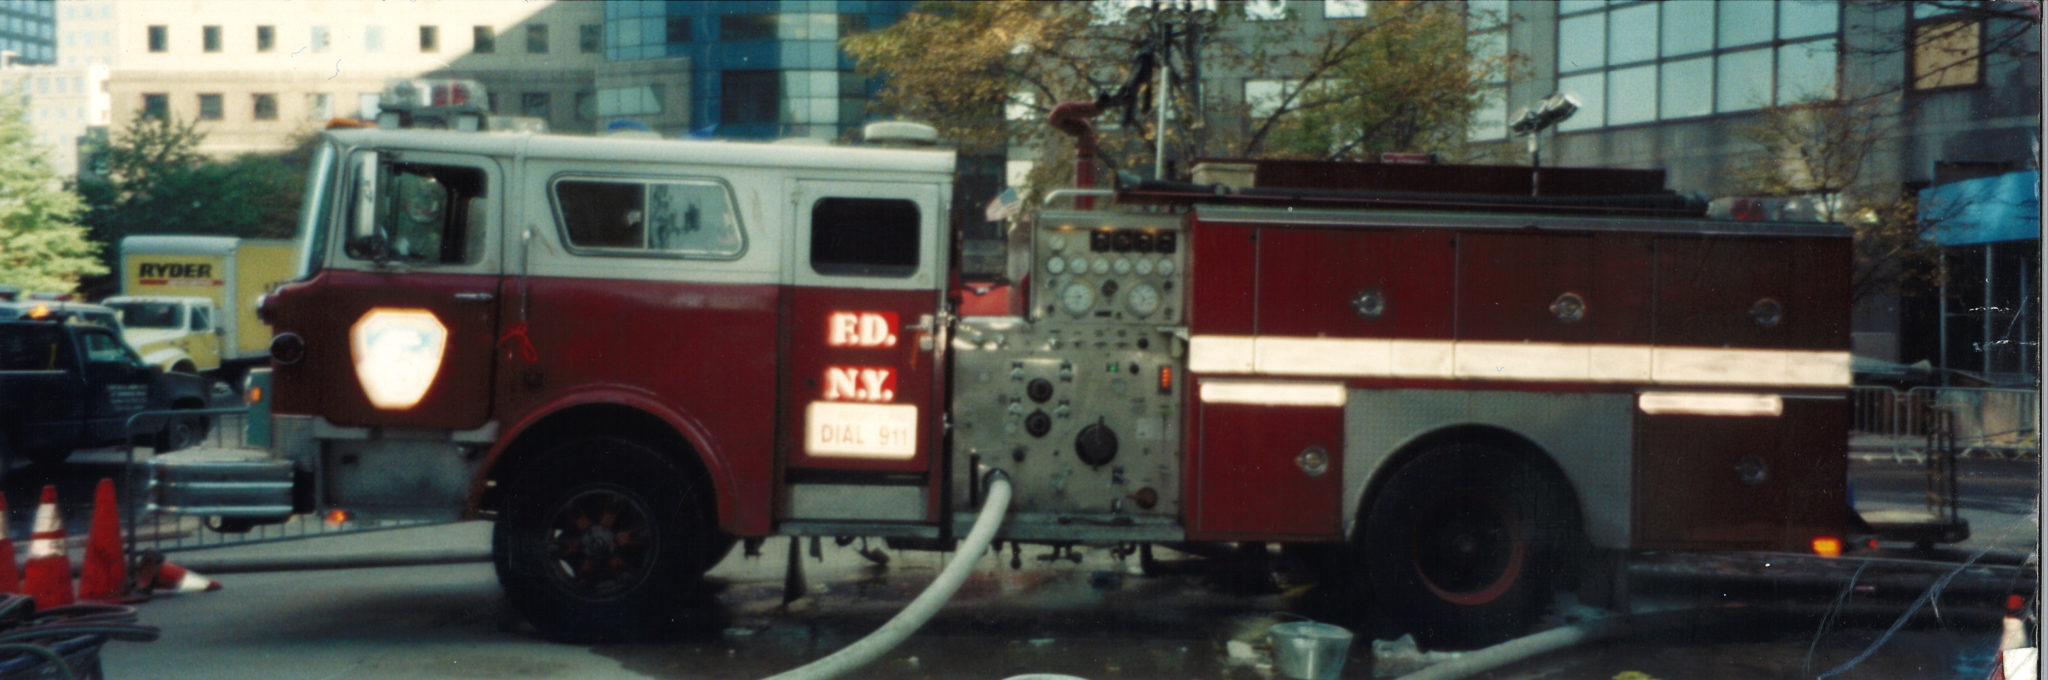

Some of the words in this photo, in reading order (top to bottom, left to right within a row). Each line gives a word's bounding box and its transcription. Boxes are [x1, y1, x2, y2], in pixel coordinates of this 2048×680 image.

[139, 263, 212, 278] RYDER
[829, 312, 897, 346] F.D.
[824, 367, 894, 401] N.Y.
[821, 424, 865, 445] DIAL
[879, 426, 908, 447] 911
